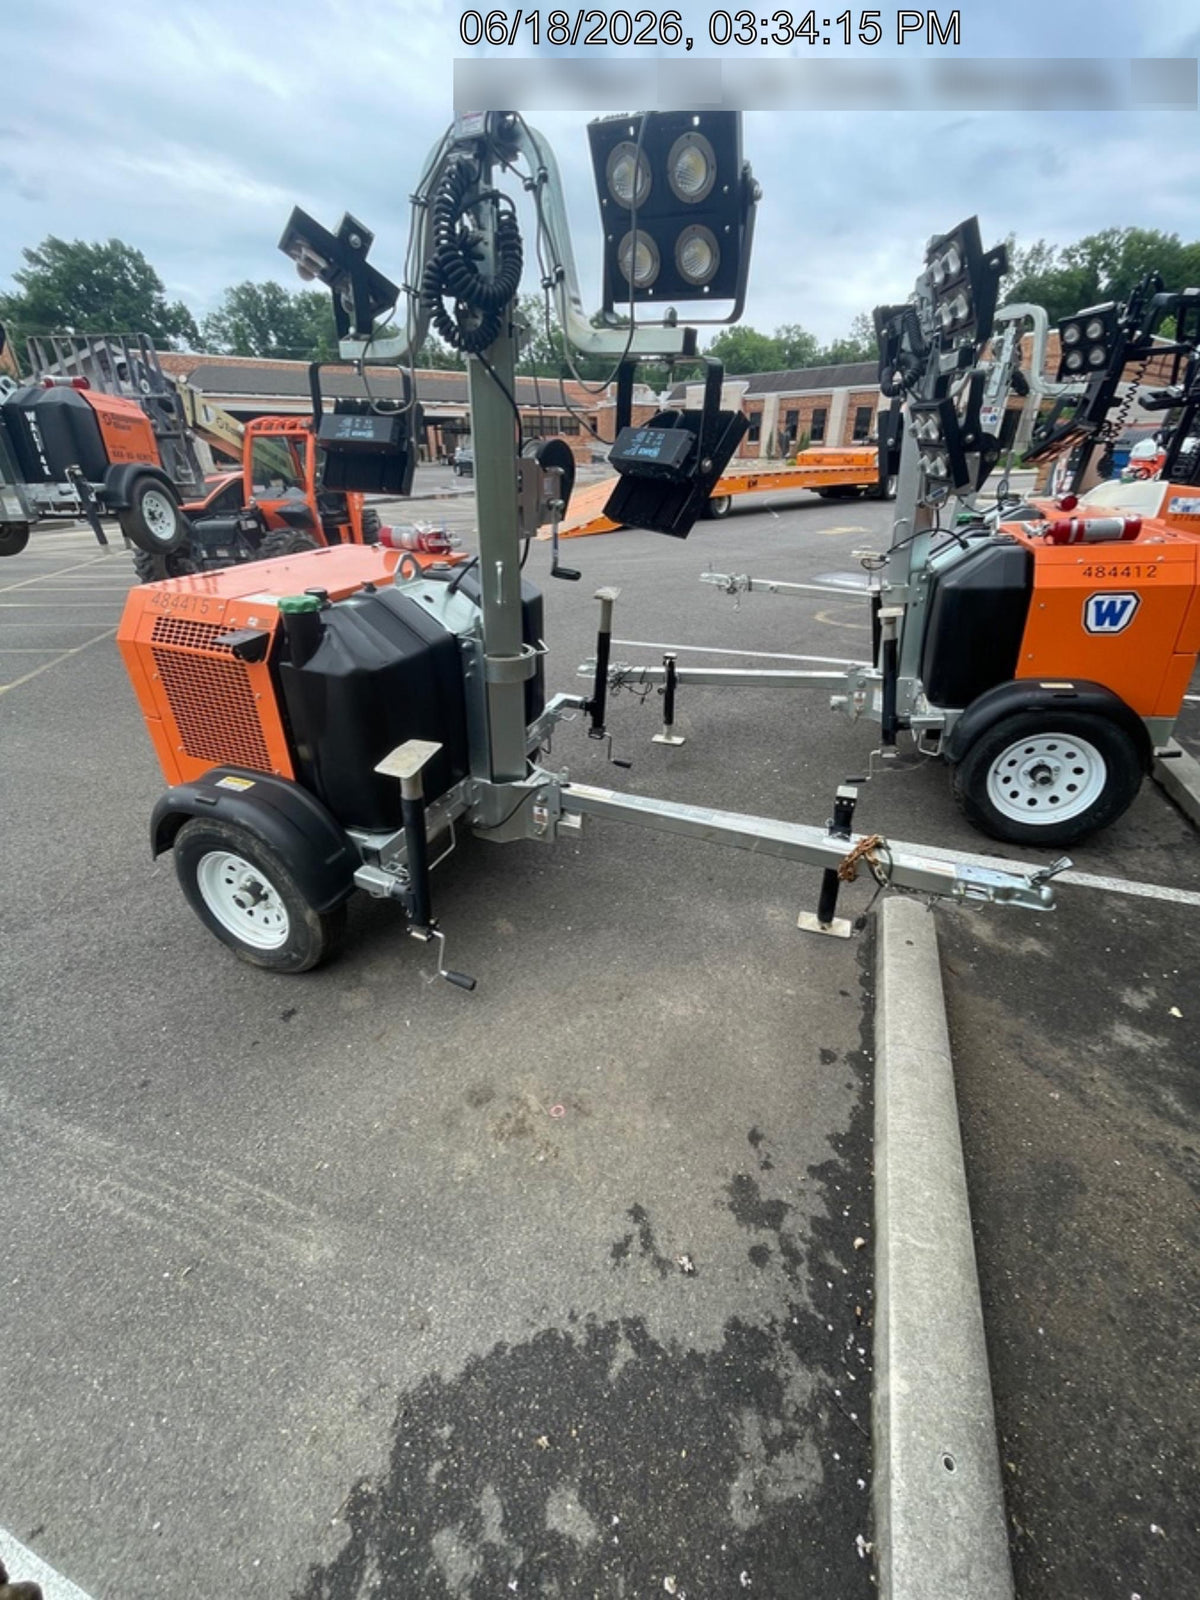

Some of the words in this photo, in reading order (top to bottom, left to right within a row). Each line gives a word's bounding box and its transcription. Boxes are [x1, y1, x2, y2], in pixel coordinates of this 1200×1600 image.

[1082, 564, 1158, 579] 484412
[151, 592, 210, 615] 484415
[1094, 600, 1132, 627] W
